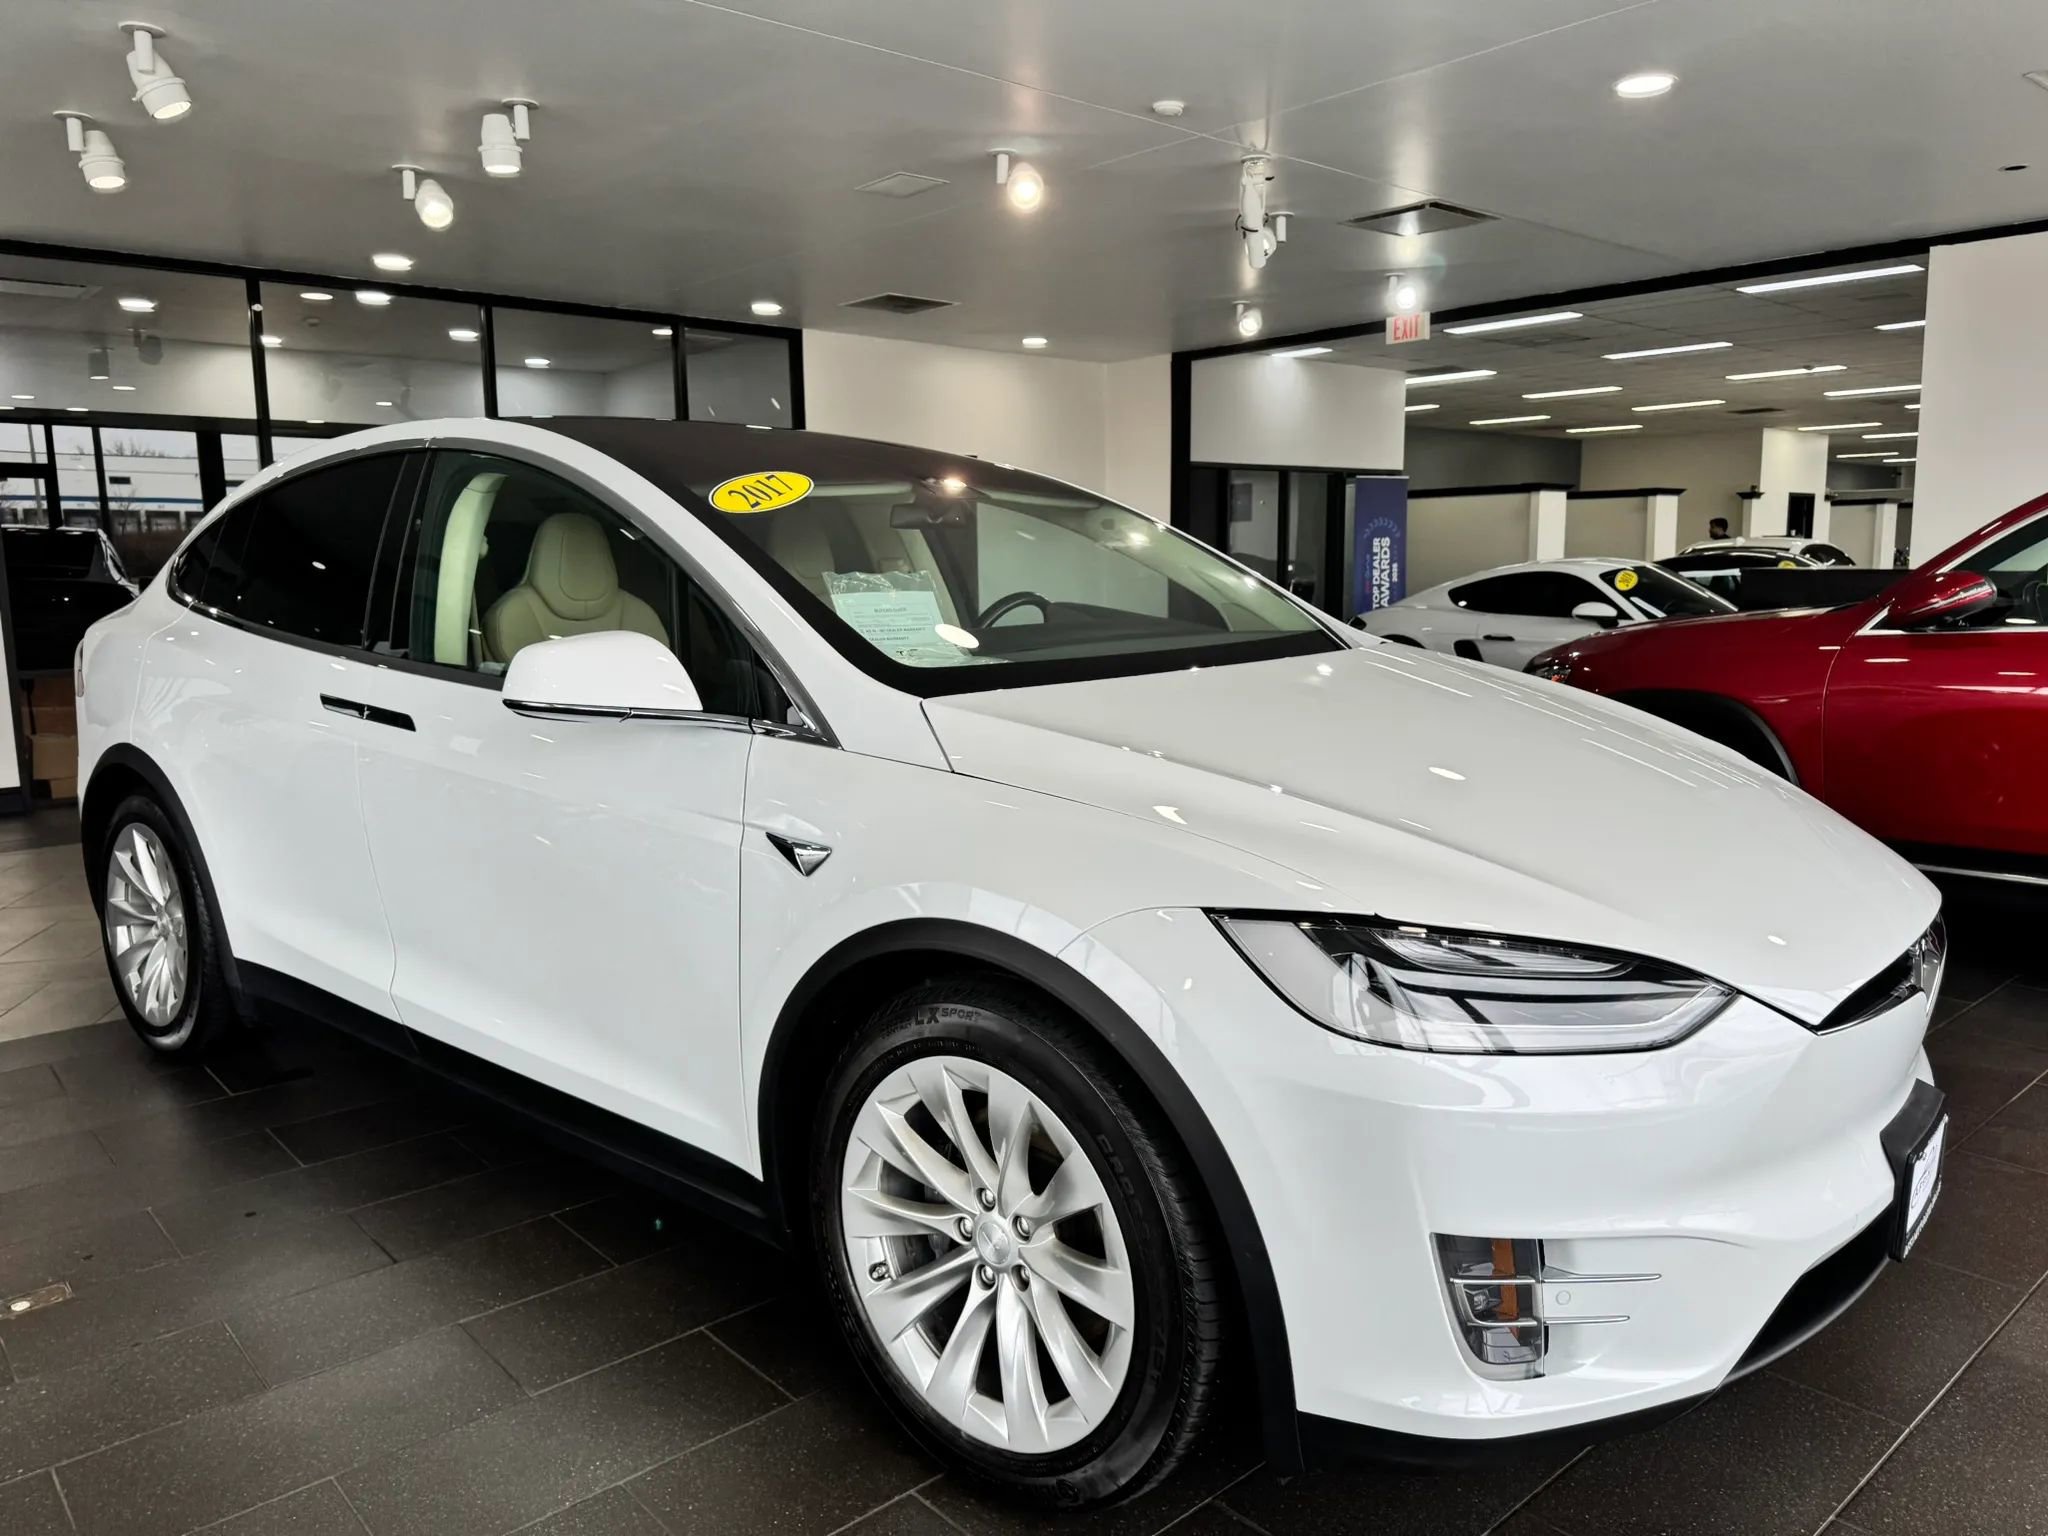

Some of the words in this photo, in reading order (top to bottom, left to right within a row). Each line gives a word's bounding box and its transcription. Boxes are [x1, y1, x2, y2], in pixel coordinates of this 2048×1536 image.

[1393, 314, 1420, 341] EXIT
[728, 474, 793, 509] 2017
[1372, 537, 1381, 585] DEALER
[1380, 536, 1391, 607] AWARDS
[1372, 586, 1381, 609] TOP
[915, 1006, 940, 1025] LX
[941, 1007, 982, 1022] SPORT
